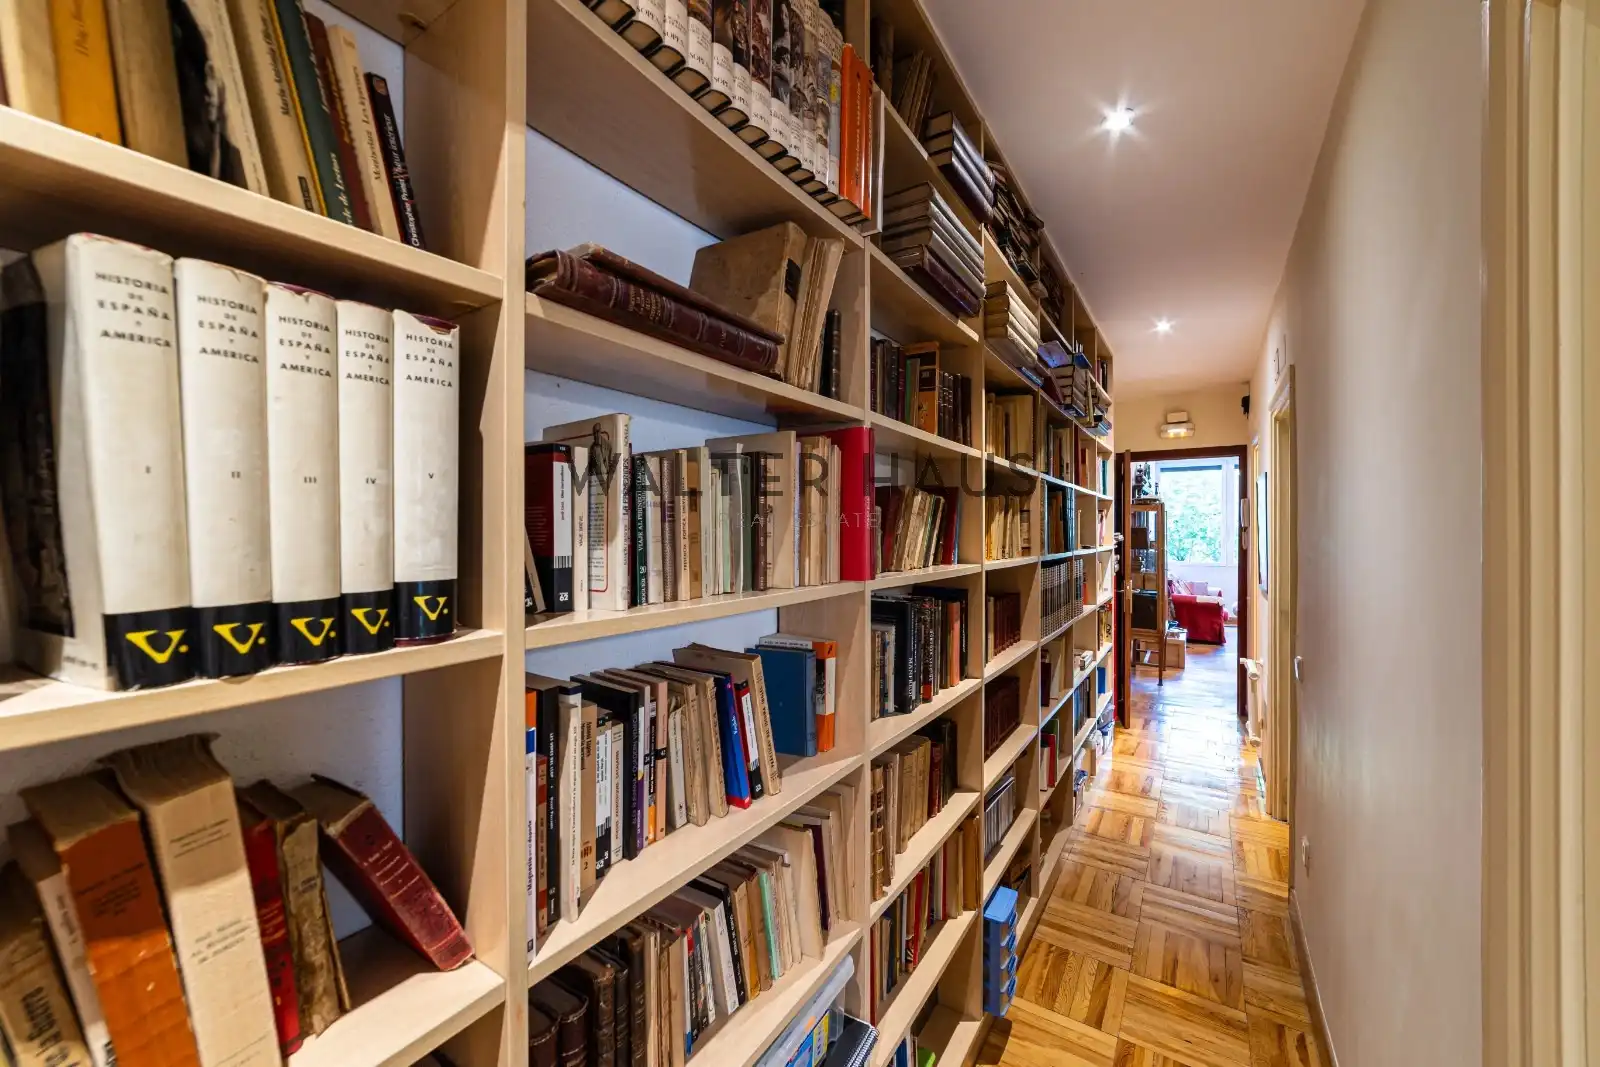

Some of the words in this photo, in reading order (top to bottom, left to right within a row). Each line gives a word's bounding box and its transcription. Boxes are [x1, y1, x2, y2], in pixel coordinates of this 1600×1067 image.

[406, 202, 420, 246] Christopher
[95, 272, 169, 294] HISTORIA
[127, 292, 144, 301] DE
[97, 300, 171, 321] ESPAÑA
[197, 295, 257, 315] HISTORIA
[224, 313, 237, 321] DE
[278, 316, 330, 333] HISTORIA
[198, 320, 258, 338] ESPAÑA
[100, 329, 172, 348] AMERICA
[345, 330, 390, 344] HISTORIA
[406, 334, 454, 349] HISTORIA
[279, 338, 331, 354] ESPAÑA
[199, 347, 259, 364] AMERICA
[346, 350, 390, 365] ESPAÑA
[406, 354, 453, 368] ESPAÑA
[280, 362, 332, 378] AMERICA
[346, 372, 390, 386] AMERICA
[406, 374, 453, 388] AMERICA
[145, 466, 150, 474] I
[231, 471, 241, 479] II
[304, 476, 318, 484] III
[366, 477, 376, 485] IV
